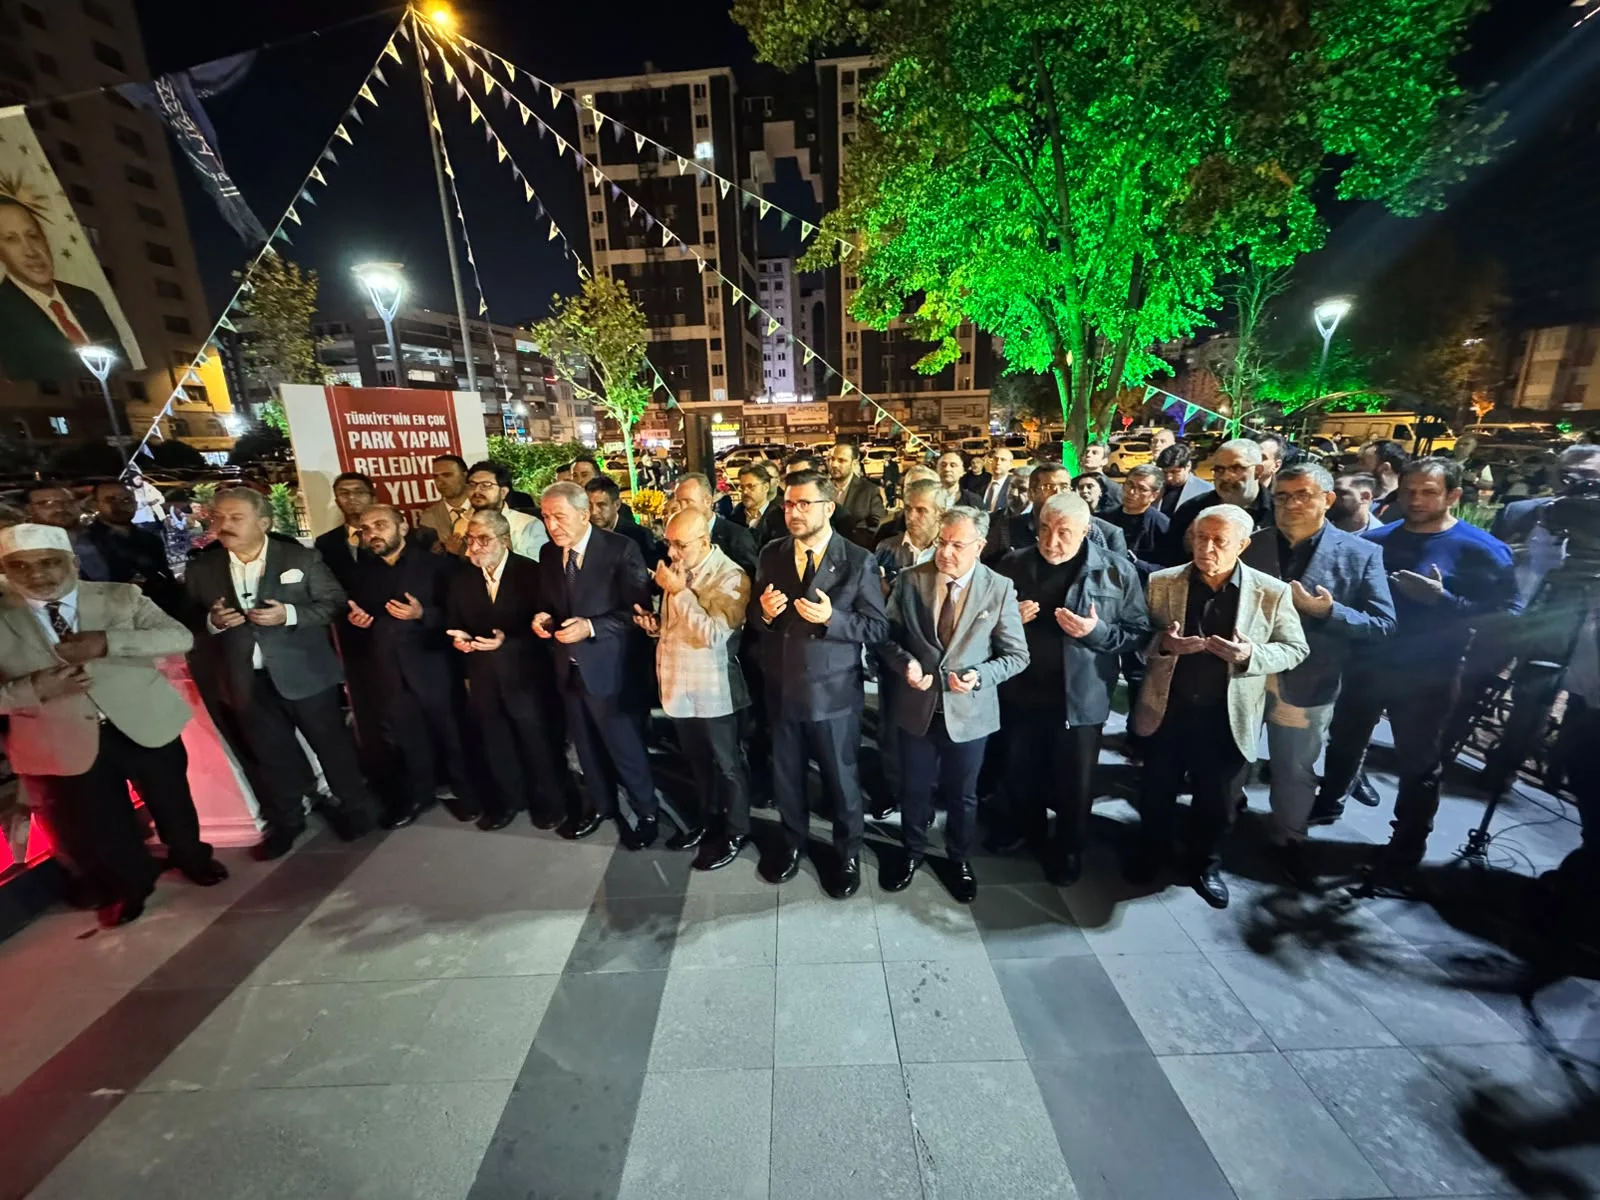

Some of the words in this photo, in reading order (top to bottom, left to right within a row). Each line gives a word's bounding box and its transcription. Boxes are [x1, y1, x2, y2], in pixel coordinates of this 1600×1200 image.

[344, 411, 411, 425] TÜRKİYE'NİN
[412, 415, 426, 425] EN
[427, 415, 446, 427] ÇOK
[348, 431, 396, 449] PARK
[397, 431, 450, 449] YAPAN
[384, 479, 442, 505] YILD
